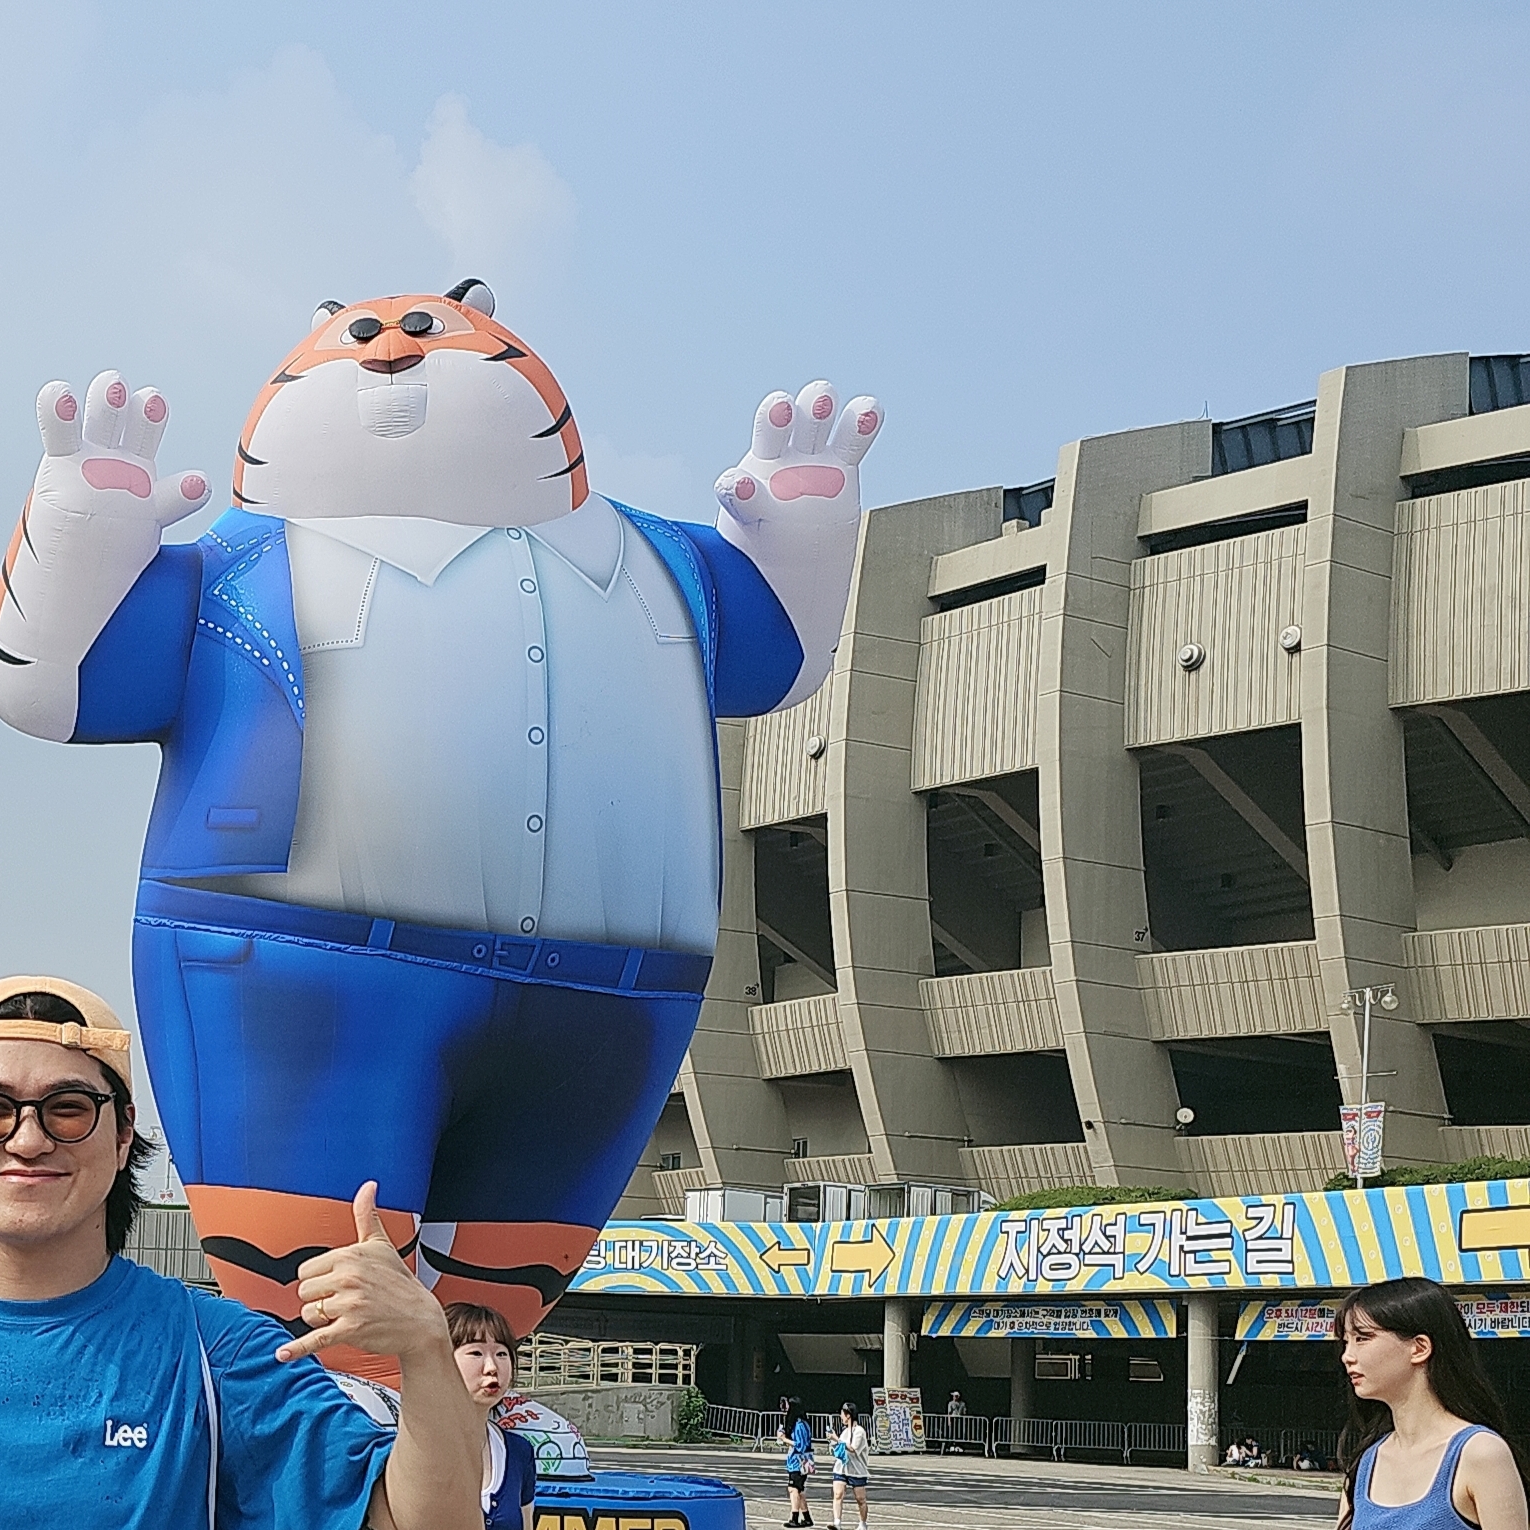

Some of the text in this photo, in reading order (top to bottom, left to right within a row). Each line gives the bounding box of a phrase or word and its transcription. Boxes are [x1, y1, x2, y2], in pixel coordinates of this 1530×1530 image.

[1134, 930, 1146, 942] 37
[745, 986, 757, 996] 38
[997, 1203, 1296, 1281] 지정석 가는 길
[613, 1239, 728, 1271] 대기장소
[1265, 1308, 1283, 1319] 오후
[1475, 1302, 1496, 1315] 모두
[1277, 1321, 1303, 1333] 반드시
[1305, 1321, 1324, 1333] 시간
[105, 1420, 147, 1448] Lee
